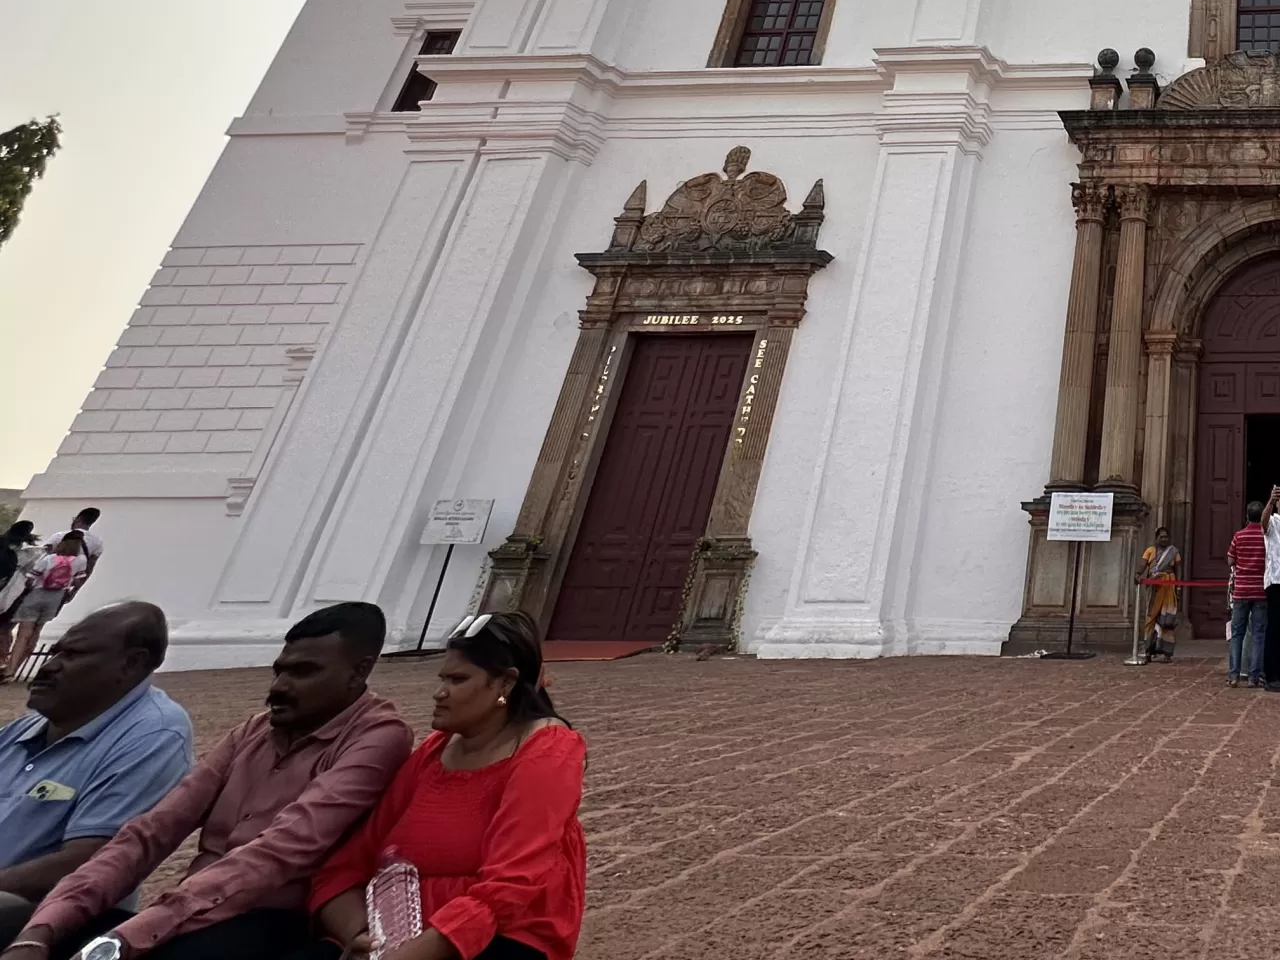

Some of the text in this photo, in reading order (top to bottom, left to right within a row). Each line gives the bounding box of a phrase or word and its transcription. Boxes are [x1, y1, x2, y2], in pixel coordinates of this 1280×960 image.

[643, 315, 743, 325] JUBILEE 2025
[754, 339, 768, 368] SEE
